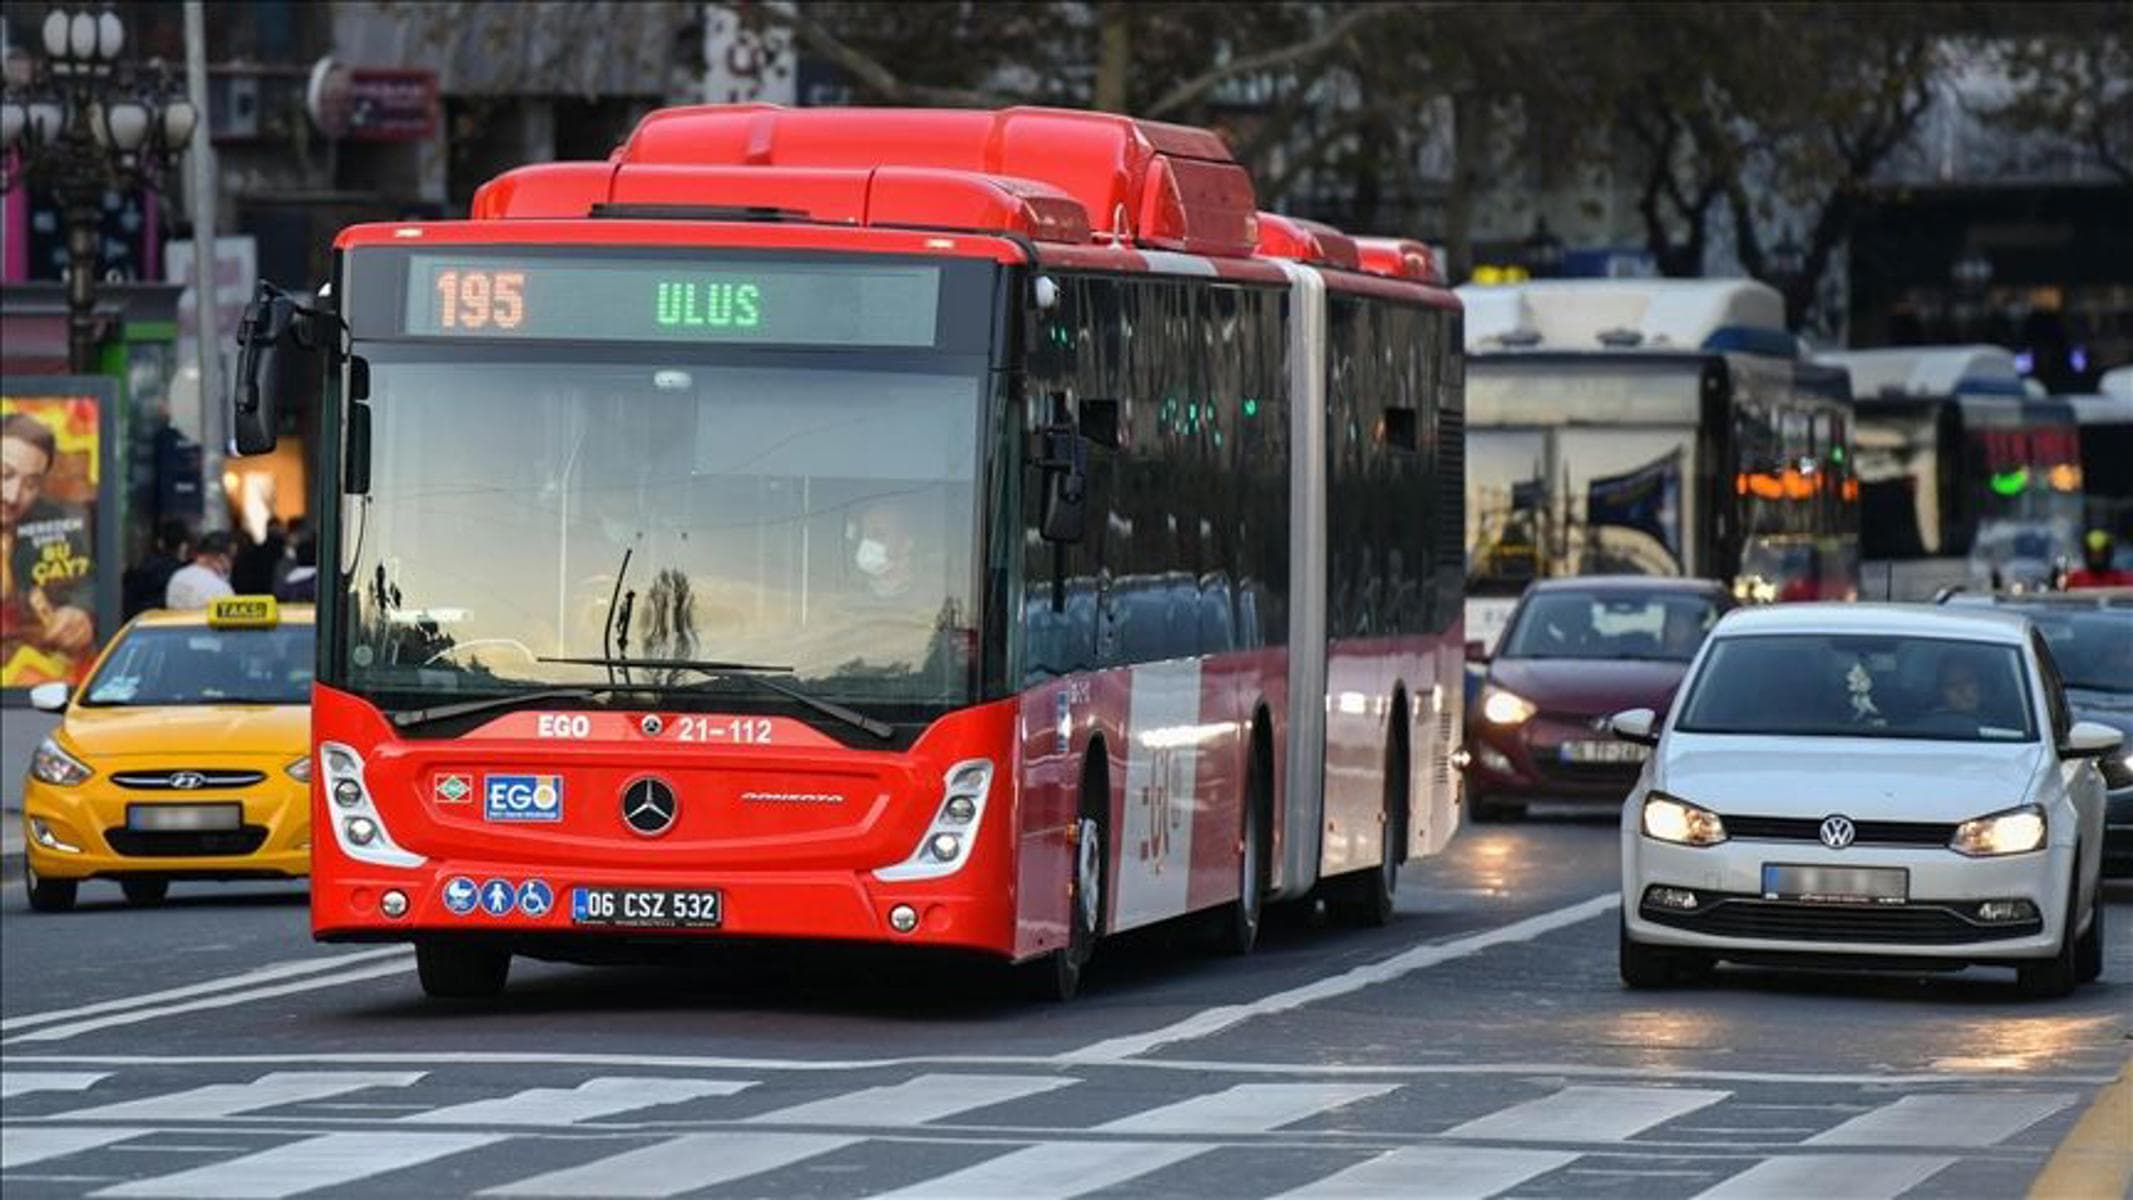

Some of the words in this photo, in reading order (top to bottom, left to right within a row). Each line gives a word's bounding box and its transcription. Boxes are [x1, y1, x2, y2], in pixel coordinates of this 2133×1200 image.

[437, 271, 525, 328] 195
[657, 282, 760, 326] ULUS
[538, 715, 590, 738] EGO
[490, 784, 557, 810] EGO
[588, 891, 615, 917] 06
[624, 892, 666, 917] CSZ
[673, 893, 715, 919] 532
